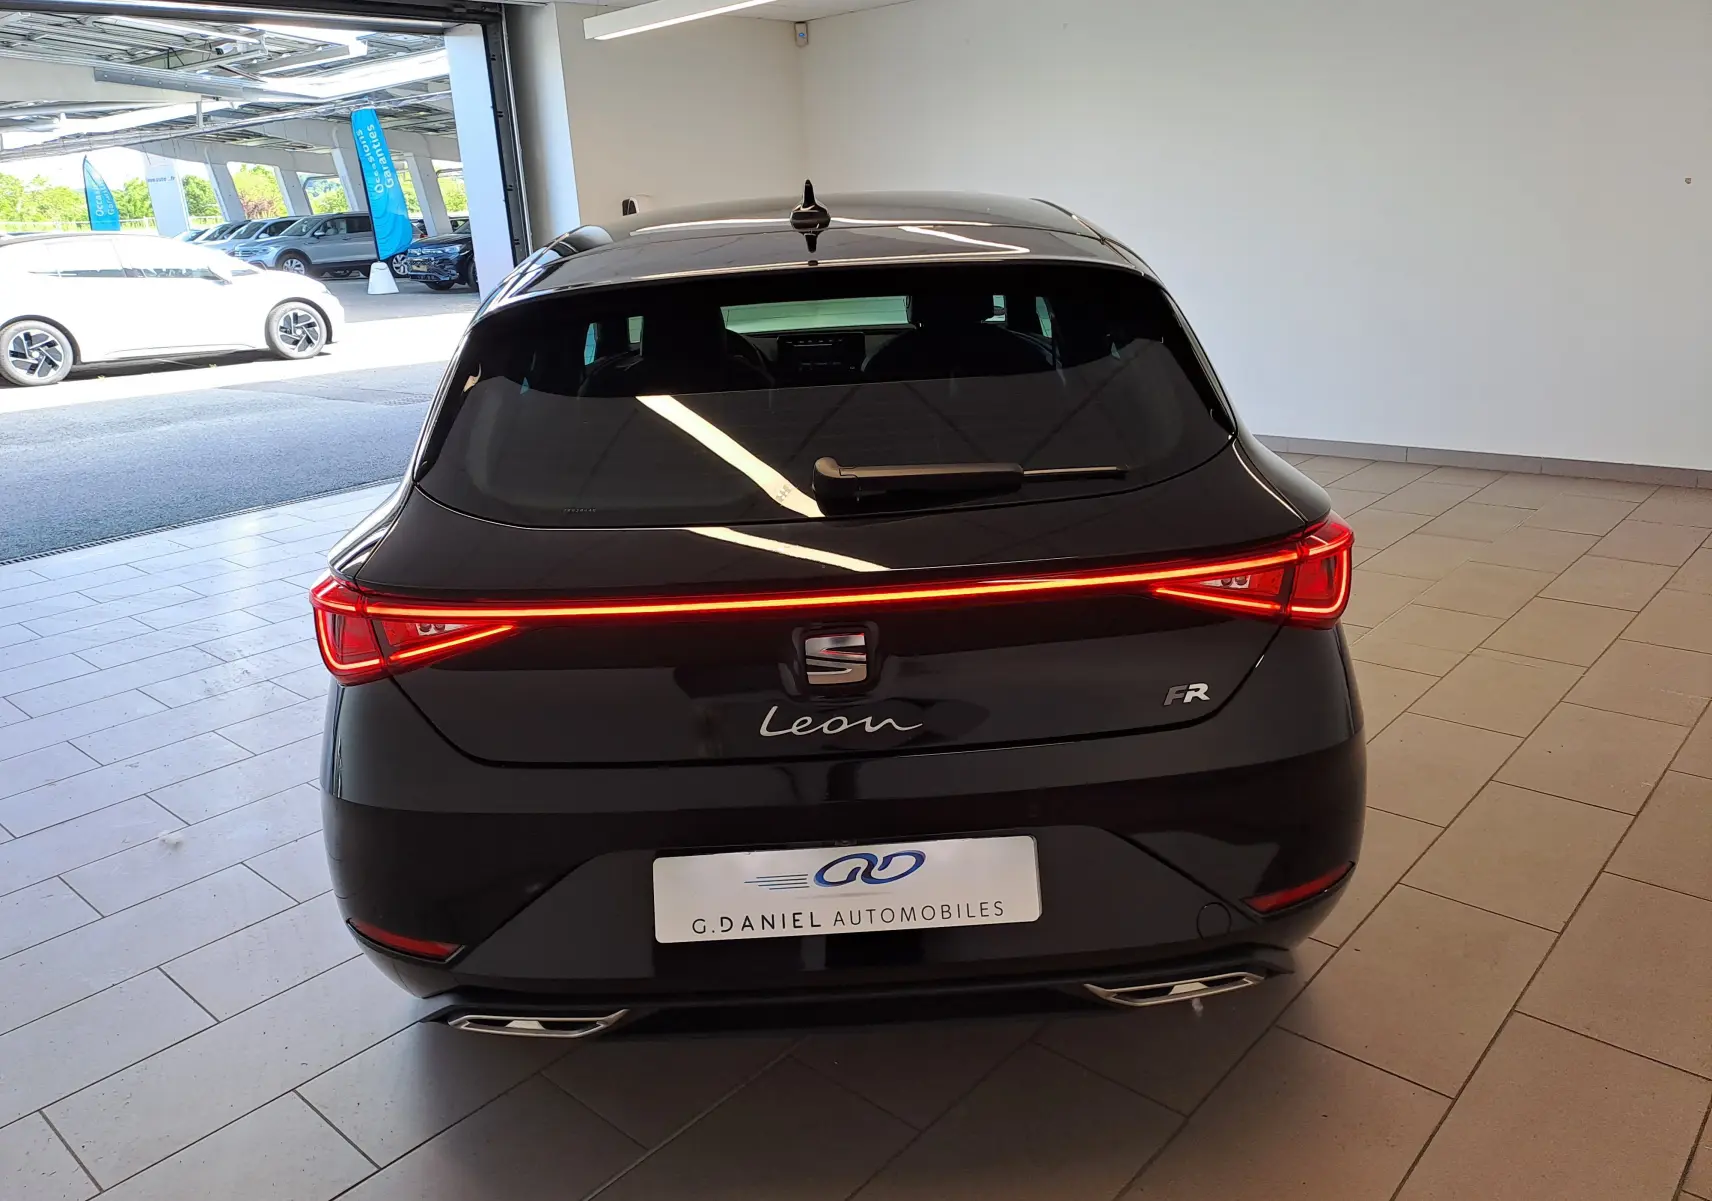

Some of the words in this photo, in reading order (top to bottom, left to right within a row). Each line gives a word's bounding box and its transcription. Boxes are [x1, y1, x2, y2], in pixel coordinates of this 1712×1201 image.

[356, 129, 384, 194] Occasions
[367, 124, 395, 188] Garanties
[1163, 682, 1211, 706] FR
[759, 705, 923, 737] Leon
[691, 911, 822, 935] G.DANIEL
[833, 900, 1004, 927] AUTOMOBILES
